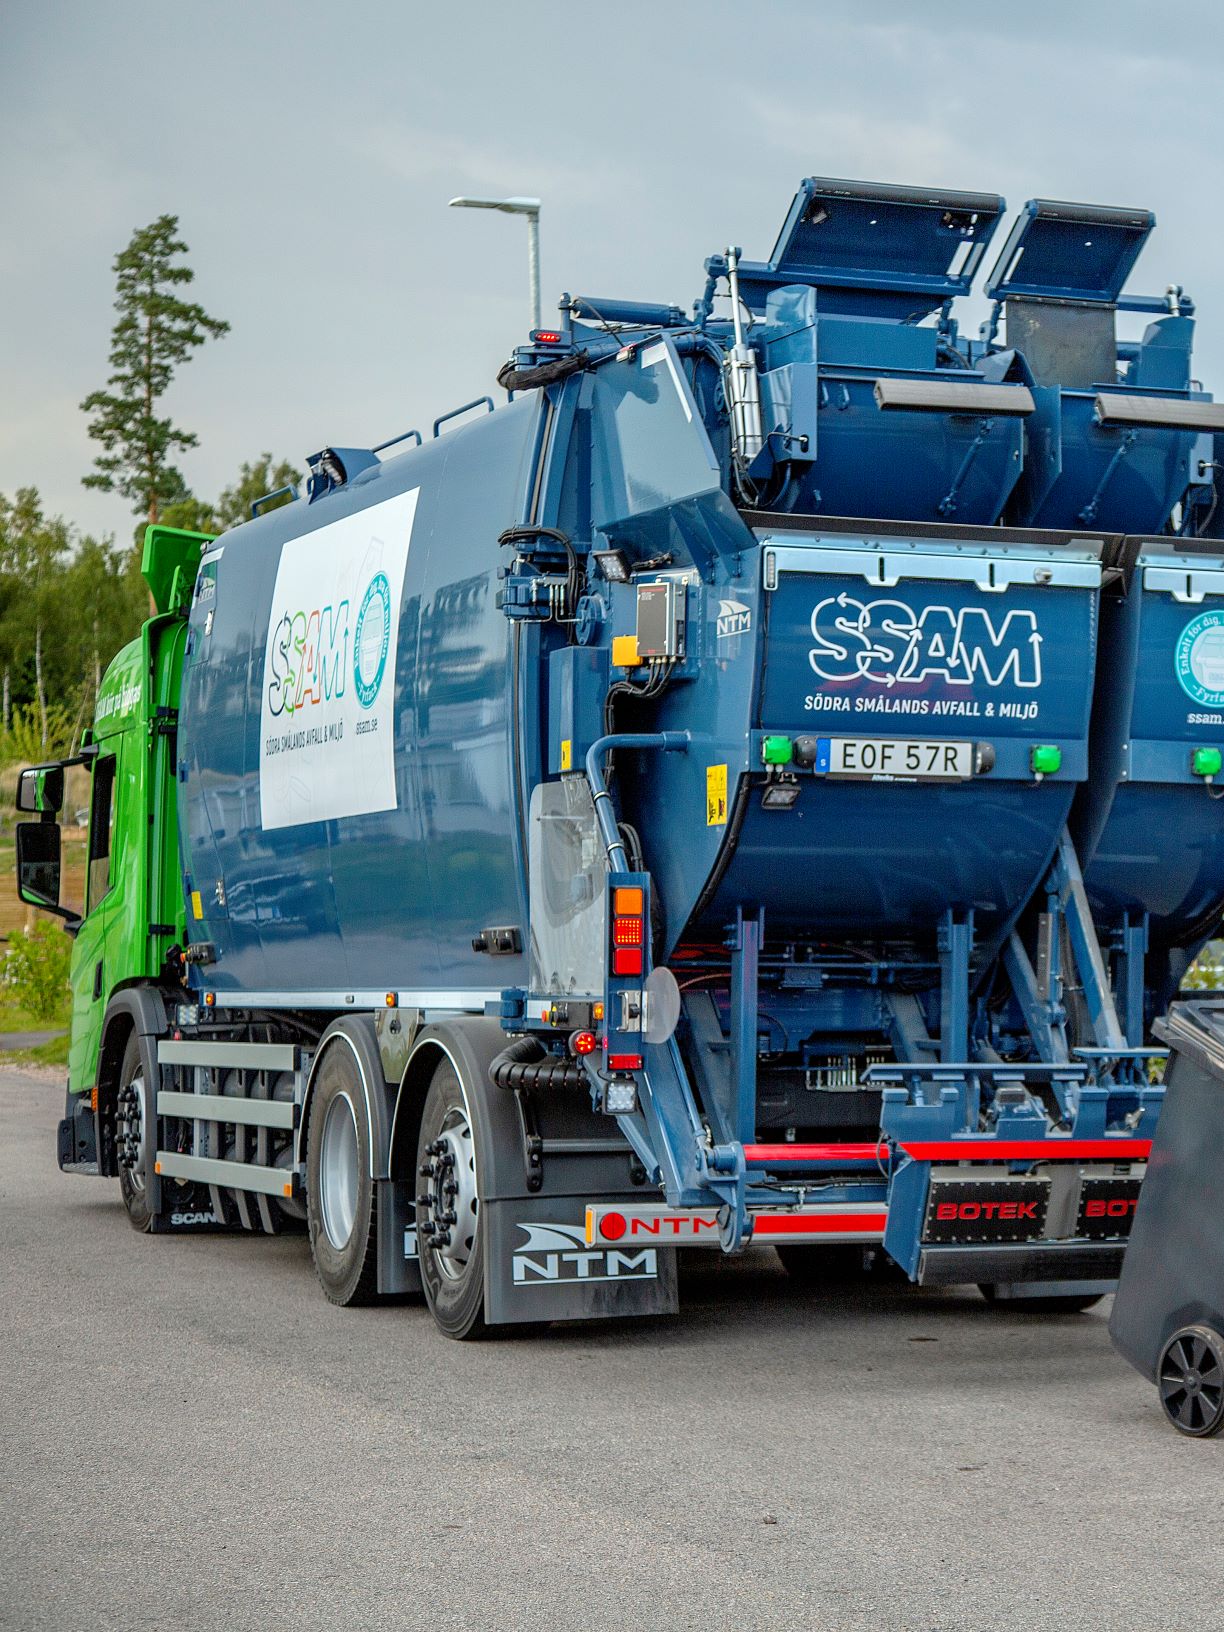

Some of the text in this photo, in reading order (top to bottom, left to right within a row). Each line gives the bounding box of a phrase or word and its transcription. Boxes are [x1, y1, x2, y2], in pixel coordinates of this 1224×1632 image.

[716, 611, 751, 636] NTM
[808, 592, 1044, 688] SSAM
[268, 599, 350, 718] SSAM
[1180, 638, 1193, 677] Enkelt
[803, 694, 1039, 721] SÖDRA SMÅLANDS AVFALL & MILJÖ
[265, 735, 281, 757] SÖDRA
[281, 729, 306, 754] SMÅLANDS
[306, 725, 324, 748] AVFALL
[820, 758, 827, 768] S
[842, 742, 959, 773] EOF 57R
[170, 1211, 219, 1225] SCAN
[936, 1201, 1039, 1221] BOTEK
[631, 1217, 717, 1235] NTM
[513, 1249, 657, 1282] NTM
